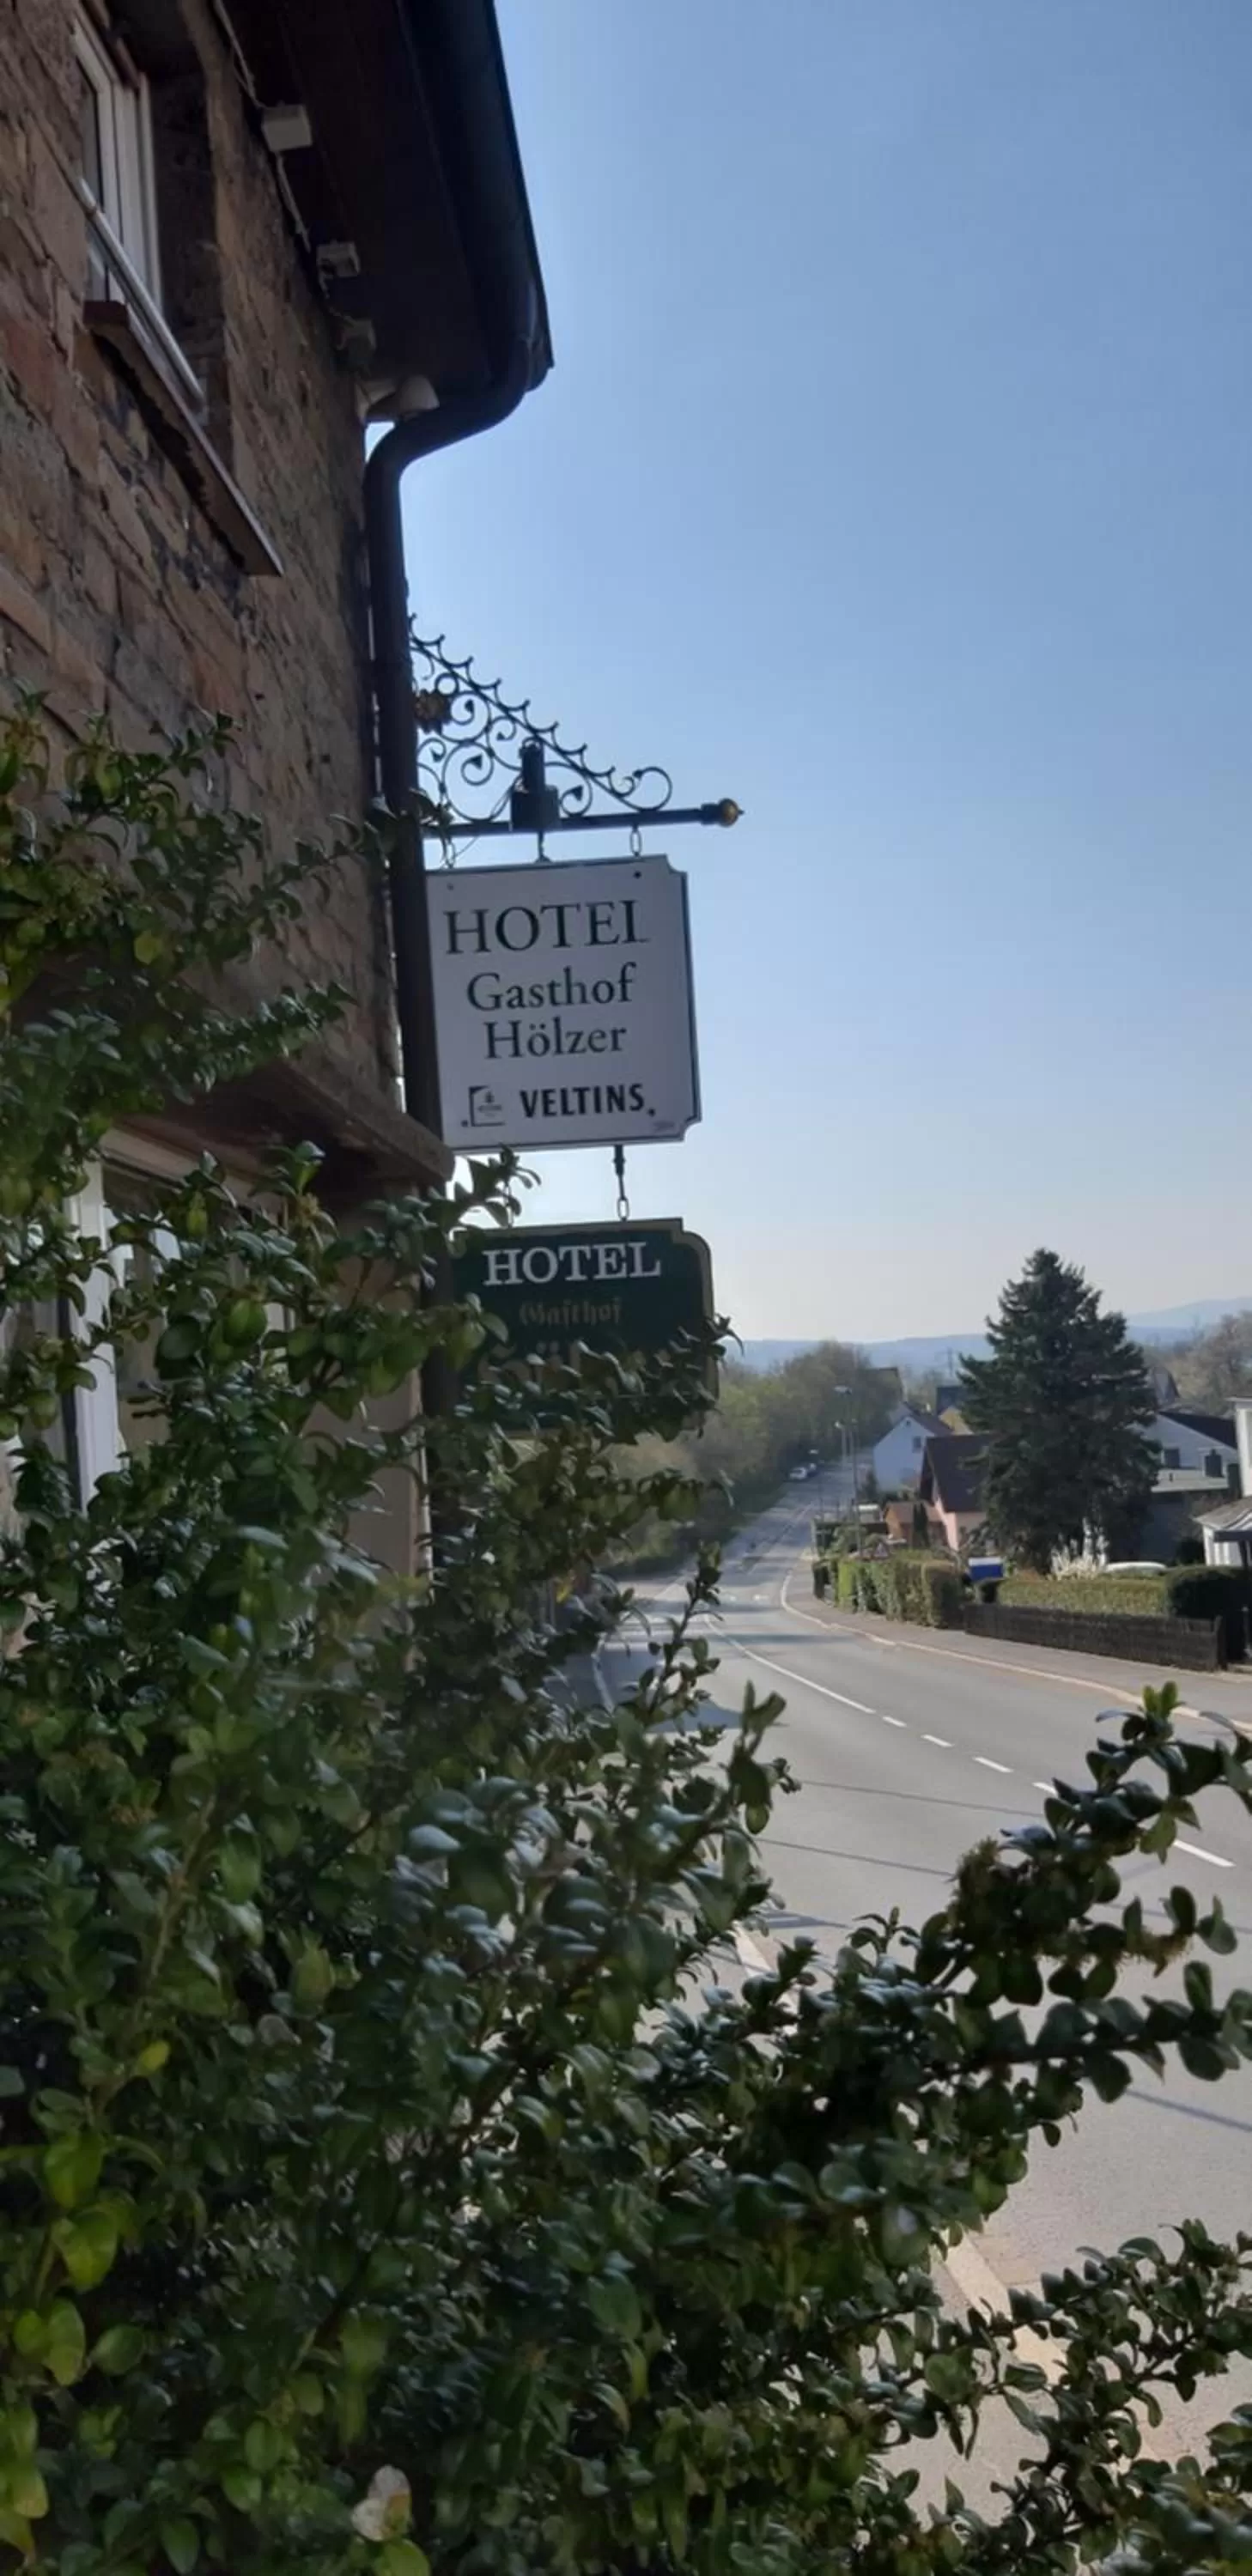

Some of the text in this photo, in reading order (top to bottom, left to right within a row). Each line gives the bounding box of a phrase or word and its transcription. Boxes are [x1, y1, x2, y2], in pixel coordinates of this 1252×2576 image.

[443, 900, 651, 955] HOTEL
[466, 962, 636, 1012] Gasthof
[483, 1015, 627, 1060] Hölzer
[520, 1083, 645, 1118] VELTINS
[482, 1242, 661, 1285] HOTEL
